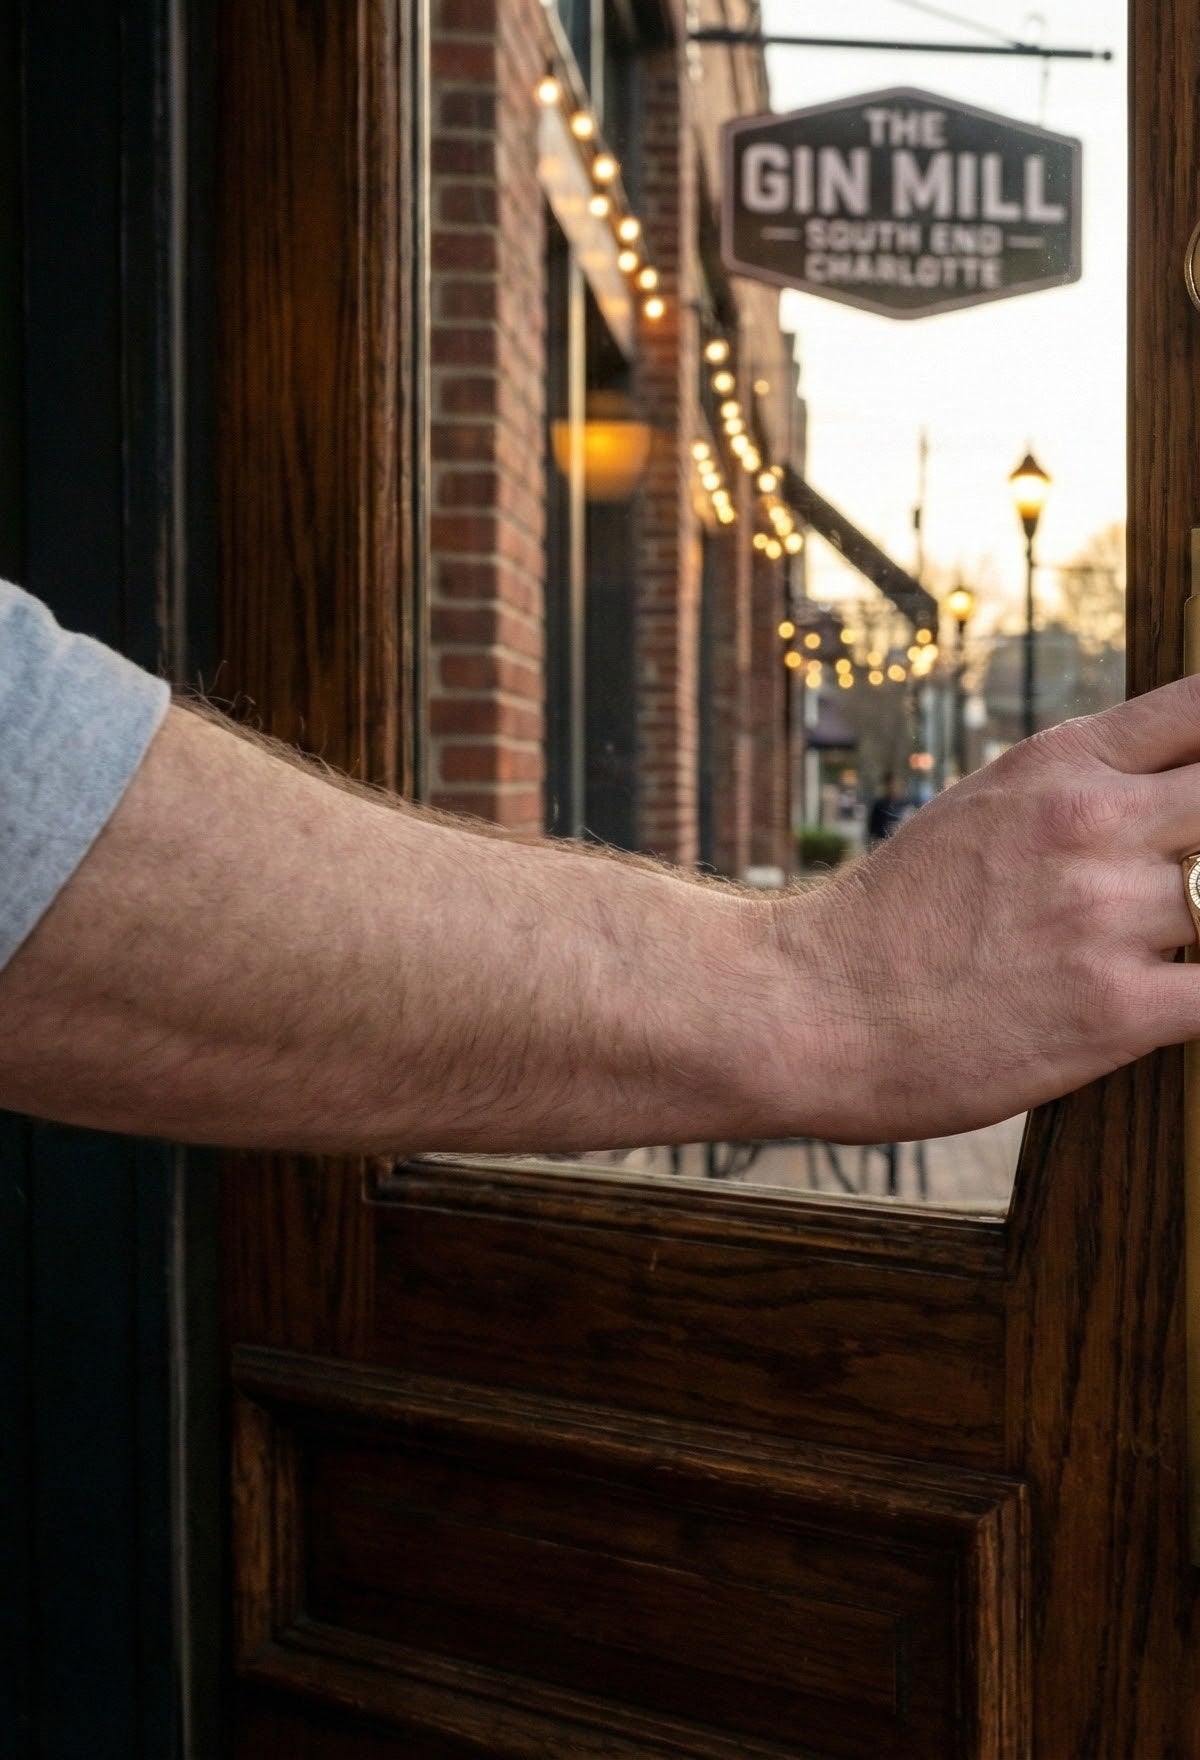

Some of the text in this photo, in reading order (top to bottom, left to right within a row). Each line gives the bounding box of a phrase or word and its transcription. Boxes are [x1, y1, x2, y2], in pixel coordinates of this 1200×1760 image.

[865, 107, 946, 147] THE
[742, 143, 1066, 223] GIN MILL
[804, 219, 1003, 255] SOUTH END
[804, 253, 1003, 289] CHARLOTTE
